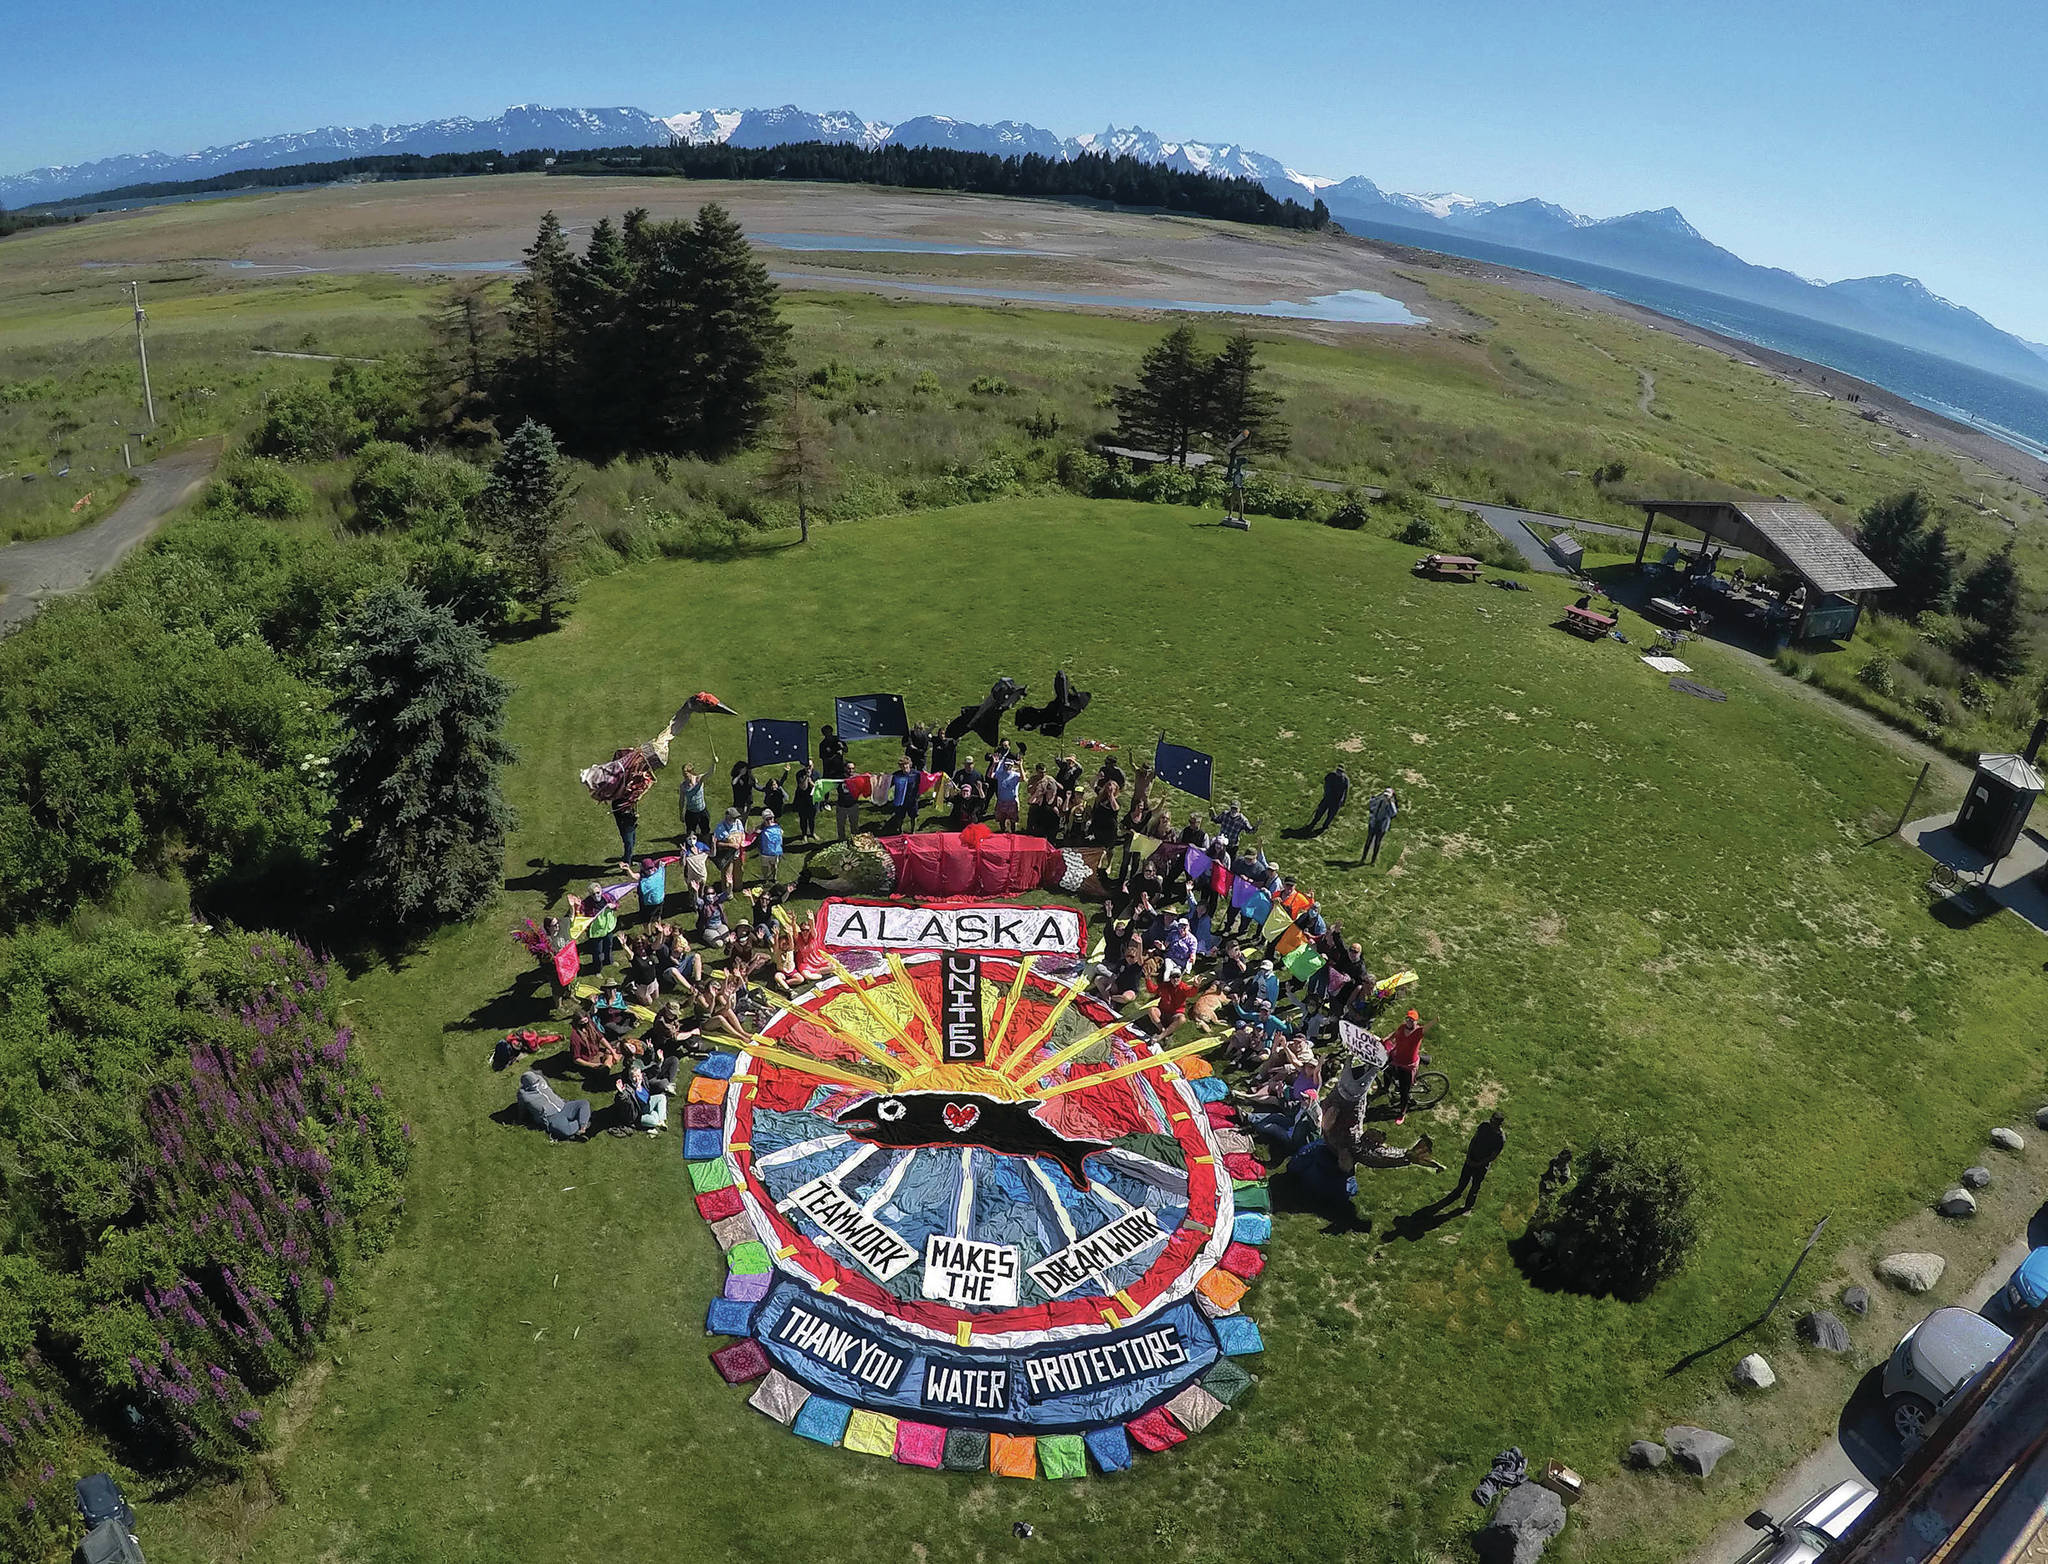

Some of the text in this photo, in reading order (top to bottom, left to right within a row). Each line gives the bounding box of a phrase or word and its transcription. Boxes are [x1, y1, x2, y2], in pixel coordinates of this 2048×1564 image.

[837, 910, 1064, 945] ALASKA
[948, 956, 977, 1058] UNITED
[1356, 1029, 1380, 1049] LOVE
[803, 1181, 908, 1275] TEAMWORK
[931, 1240, 1013, 1277] MAKES
[947, 1273, 992, 1302] THE
[779, 1306, 903, 1390] THANK YOU
[1025, 1327, 1189, 1394] PROTECTORS
[926, 1365, 1007, 1409] WATER
